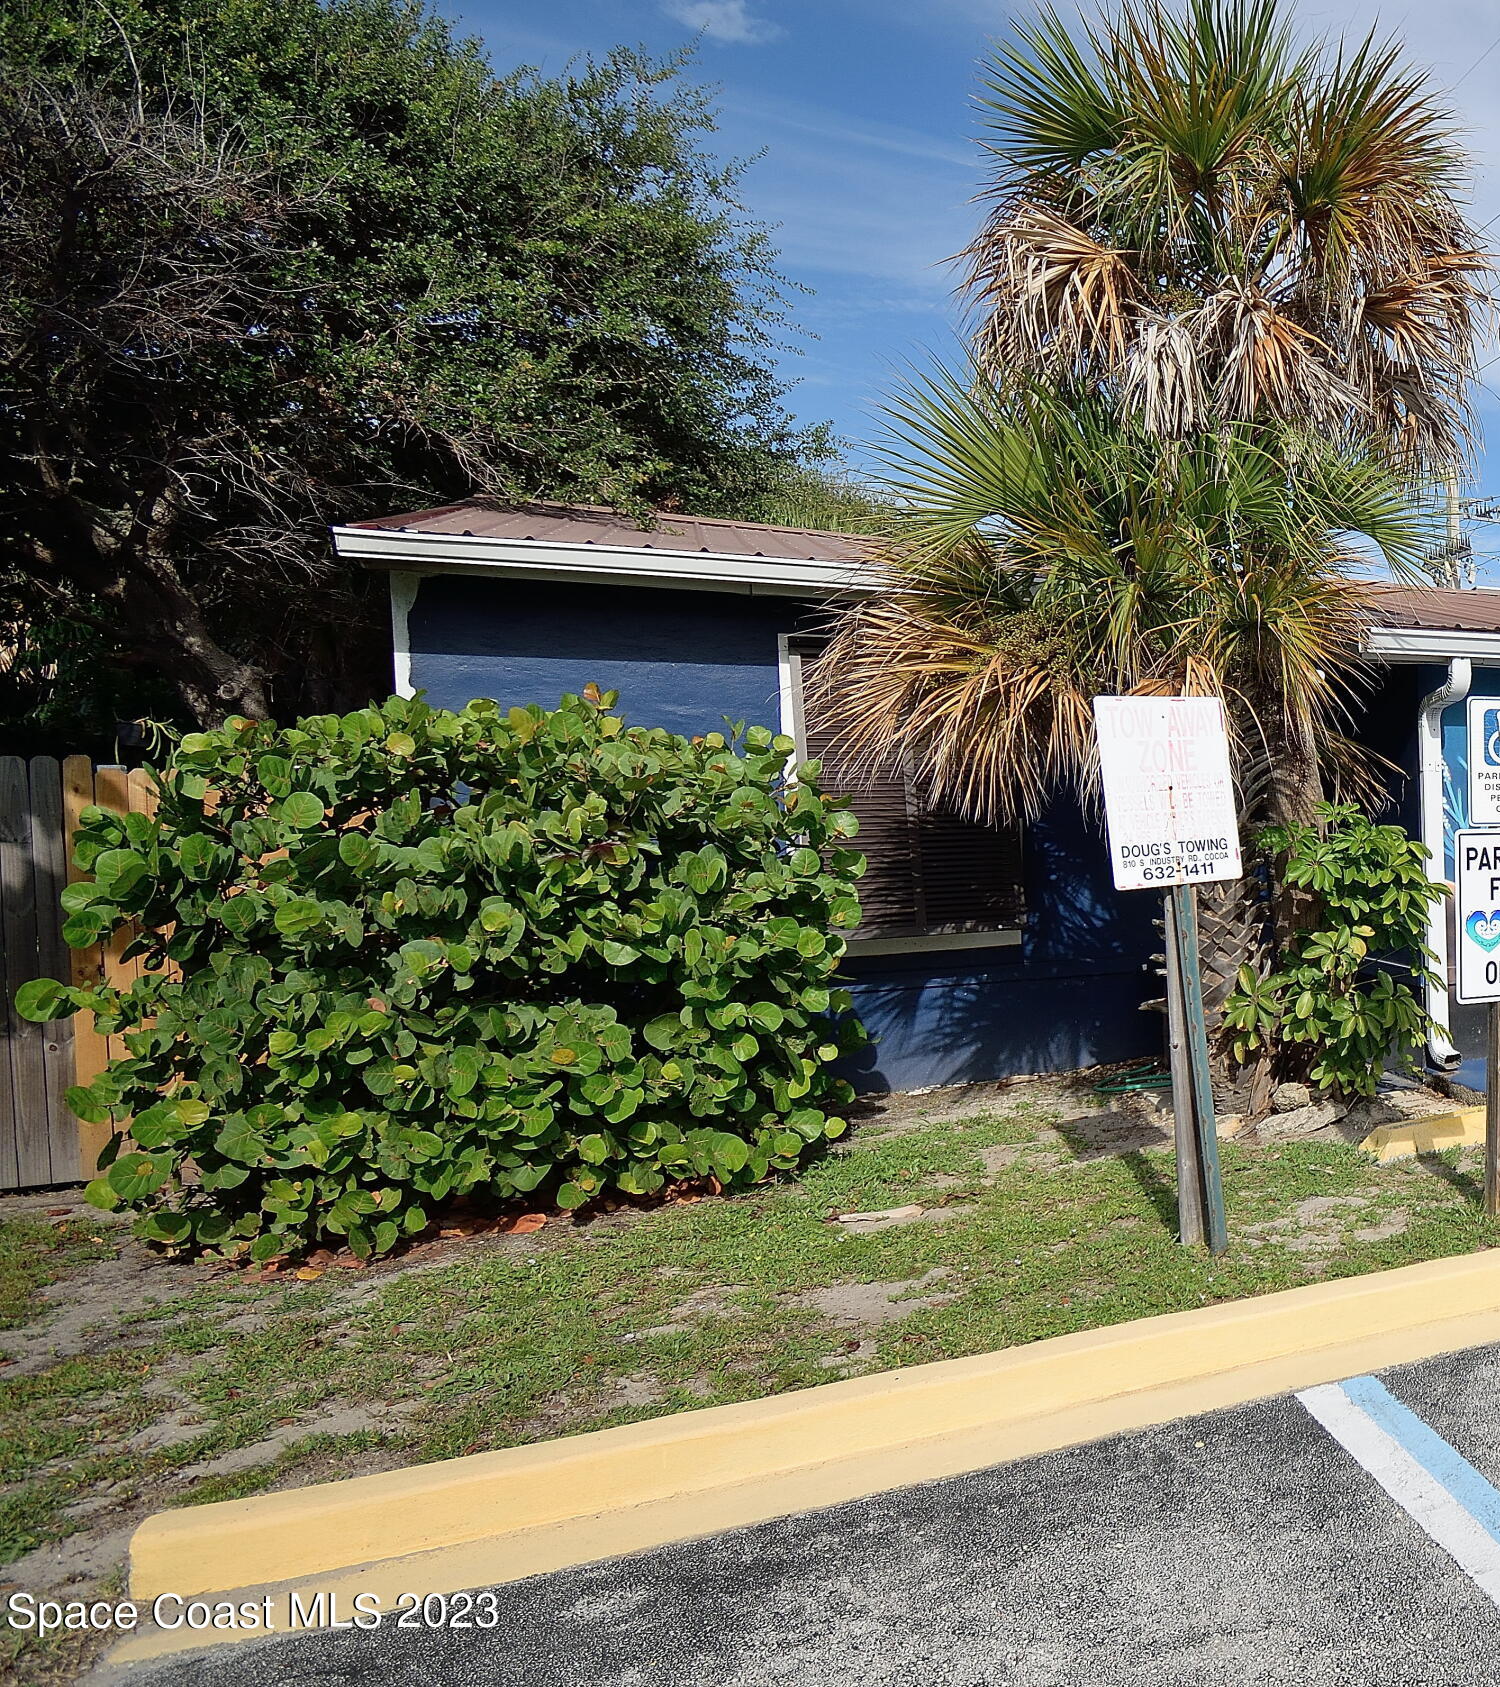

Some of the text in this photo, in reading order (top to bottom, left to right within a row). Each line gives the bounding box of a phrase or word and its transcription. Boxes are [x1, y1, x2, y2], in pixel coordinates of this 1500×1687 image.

[1121, 837, 1228, 858] DOUG'S TOWING
[1122, 860, 1136, 868] 810
[1140, 858, 1145, 867] S
[1149, 855, 1184, 866] INDUSTRY
[1204, 852, 1229, 861] COCOA
[1143, 862, 1214, 880] 632-1411
